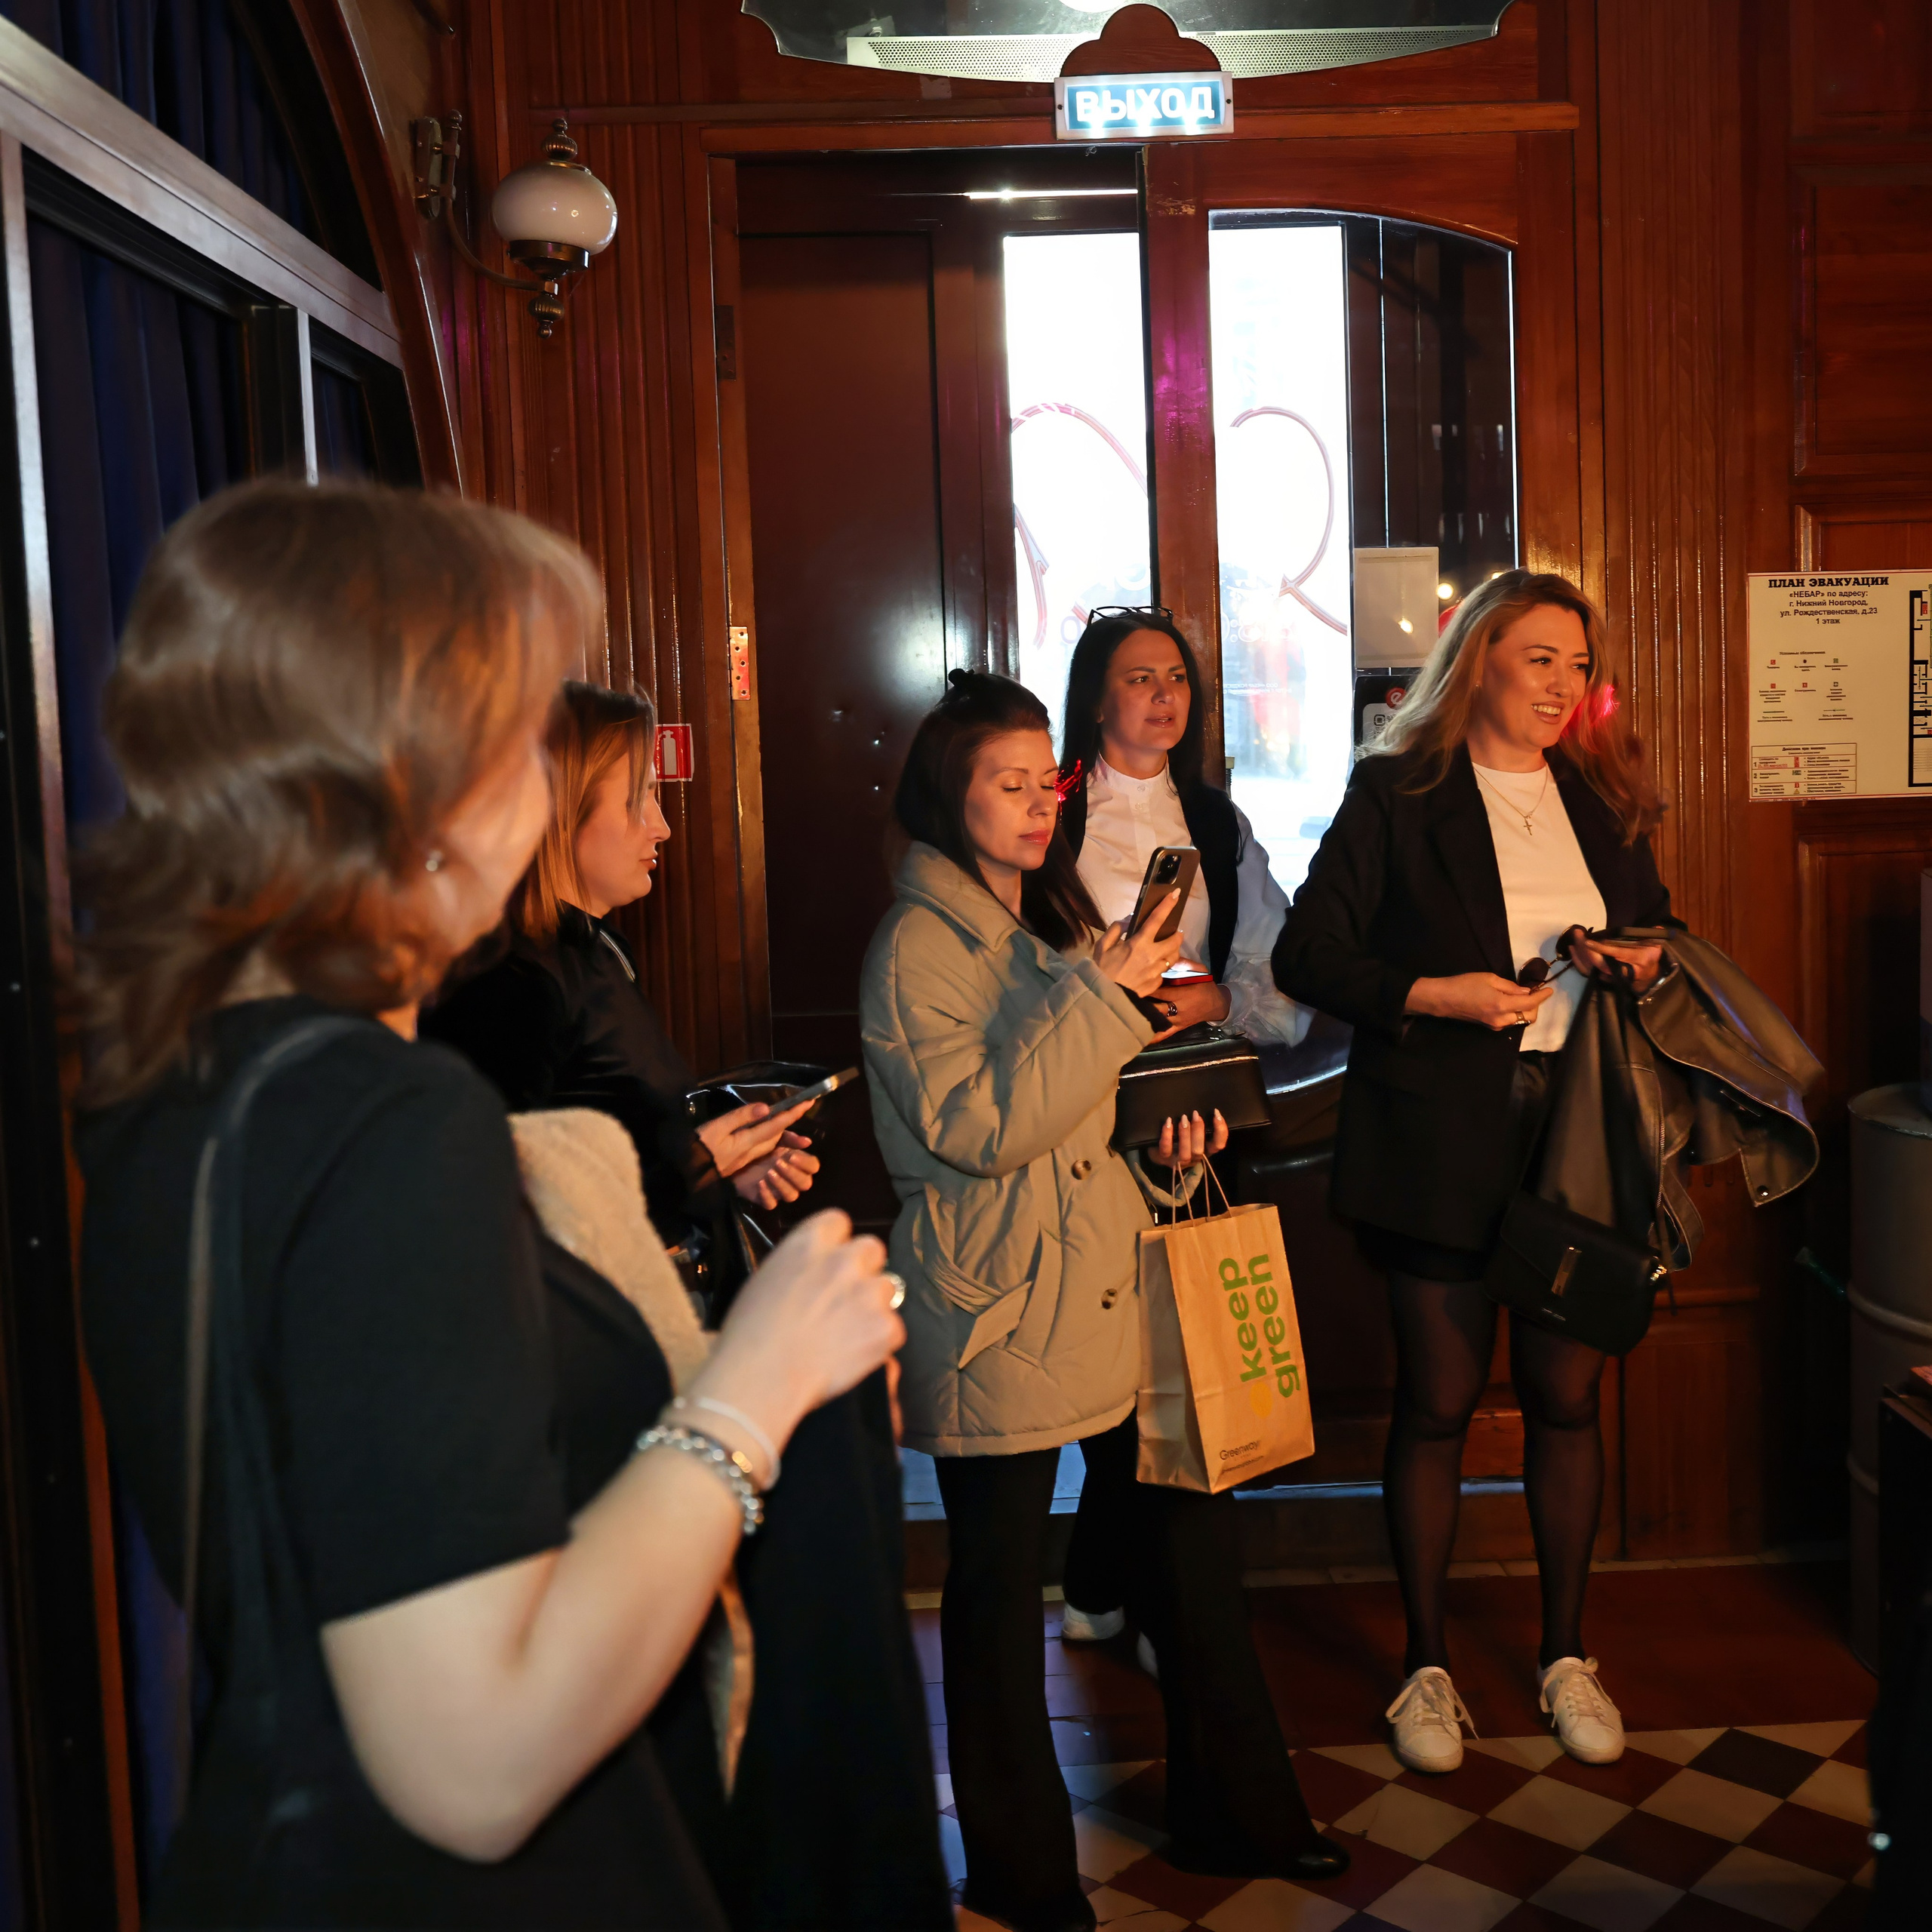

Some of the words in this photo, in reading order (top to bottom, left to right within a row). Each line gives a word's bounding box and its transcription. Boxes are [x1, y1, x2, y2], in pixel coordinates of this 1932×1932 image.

[1075, 86, 1215, 122] ВЫХОД
[1768, 579, 1805, 588] ПЛАН
[1808, 577, 1889, 587] ЭВАКУАЦИИ
[1219, 1257, 1268, 1383] keep
[1247, 1254, 1300, 1398] green
